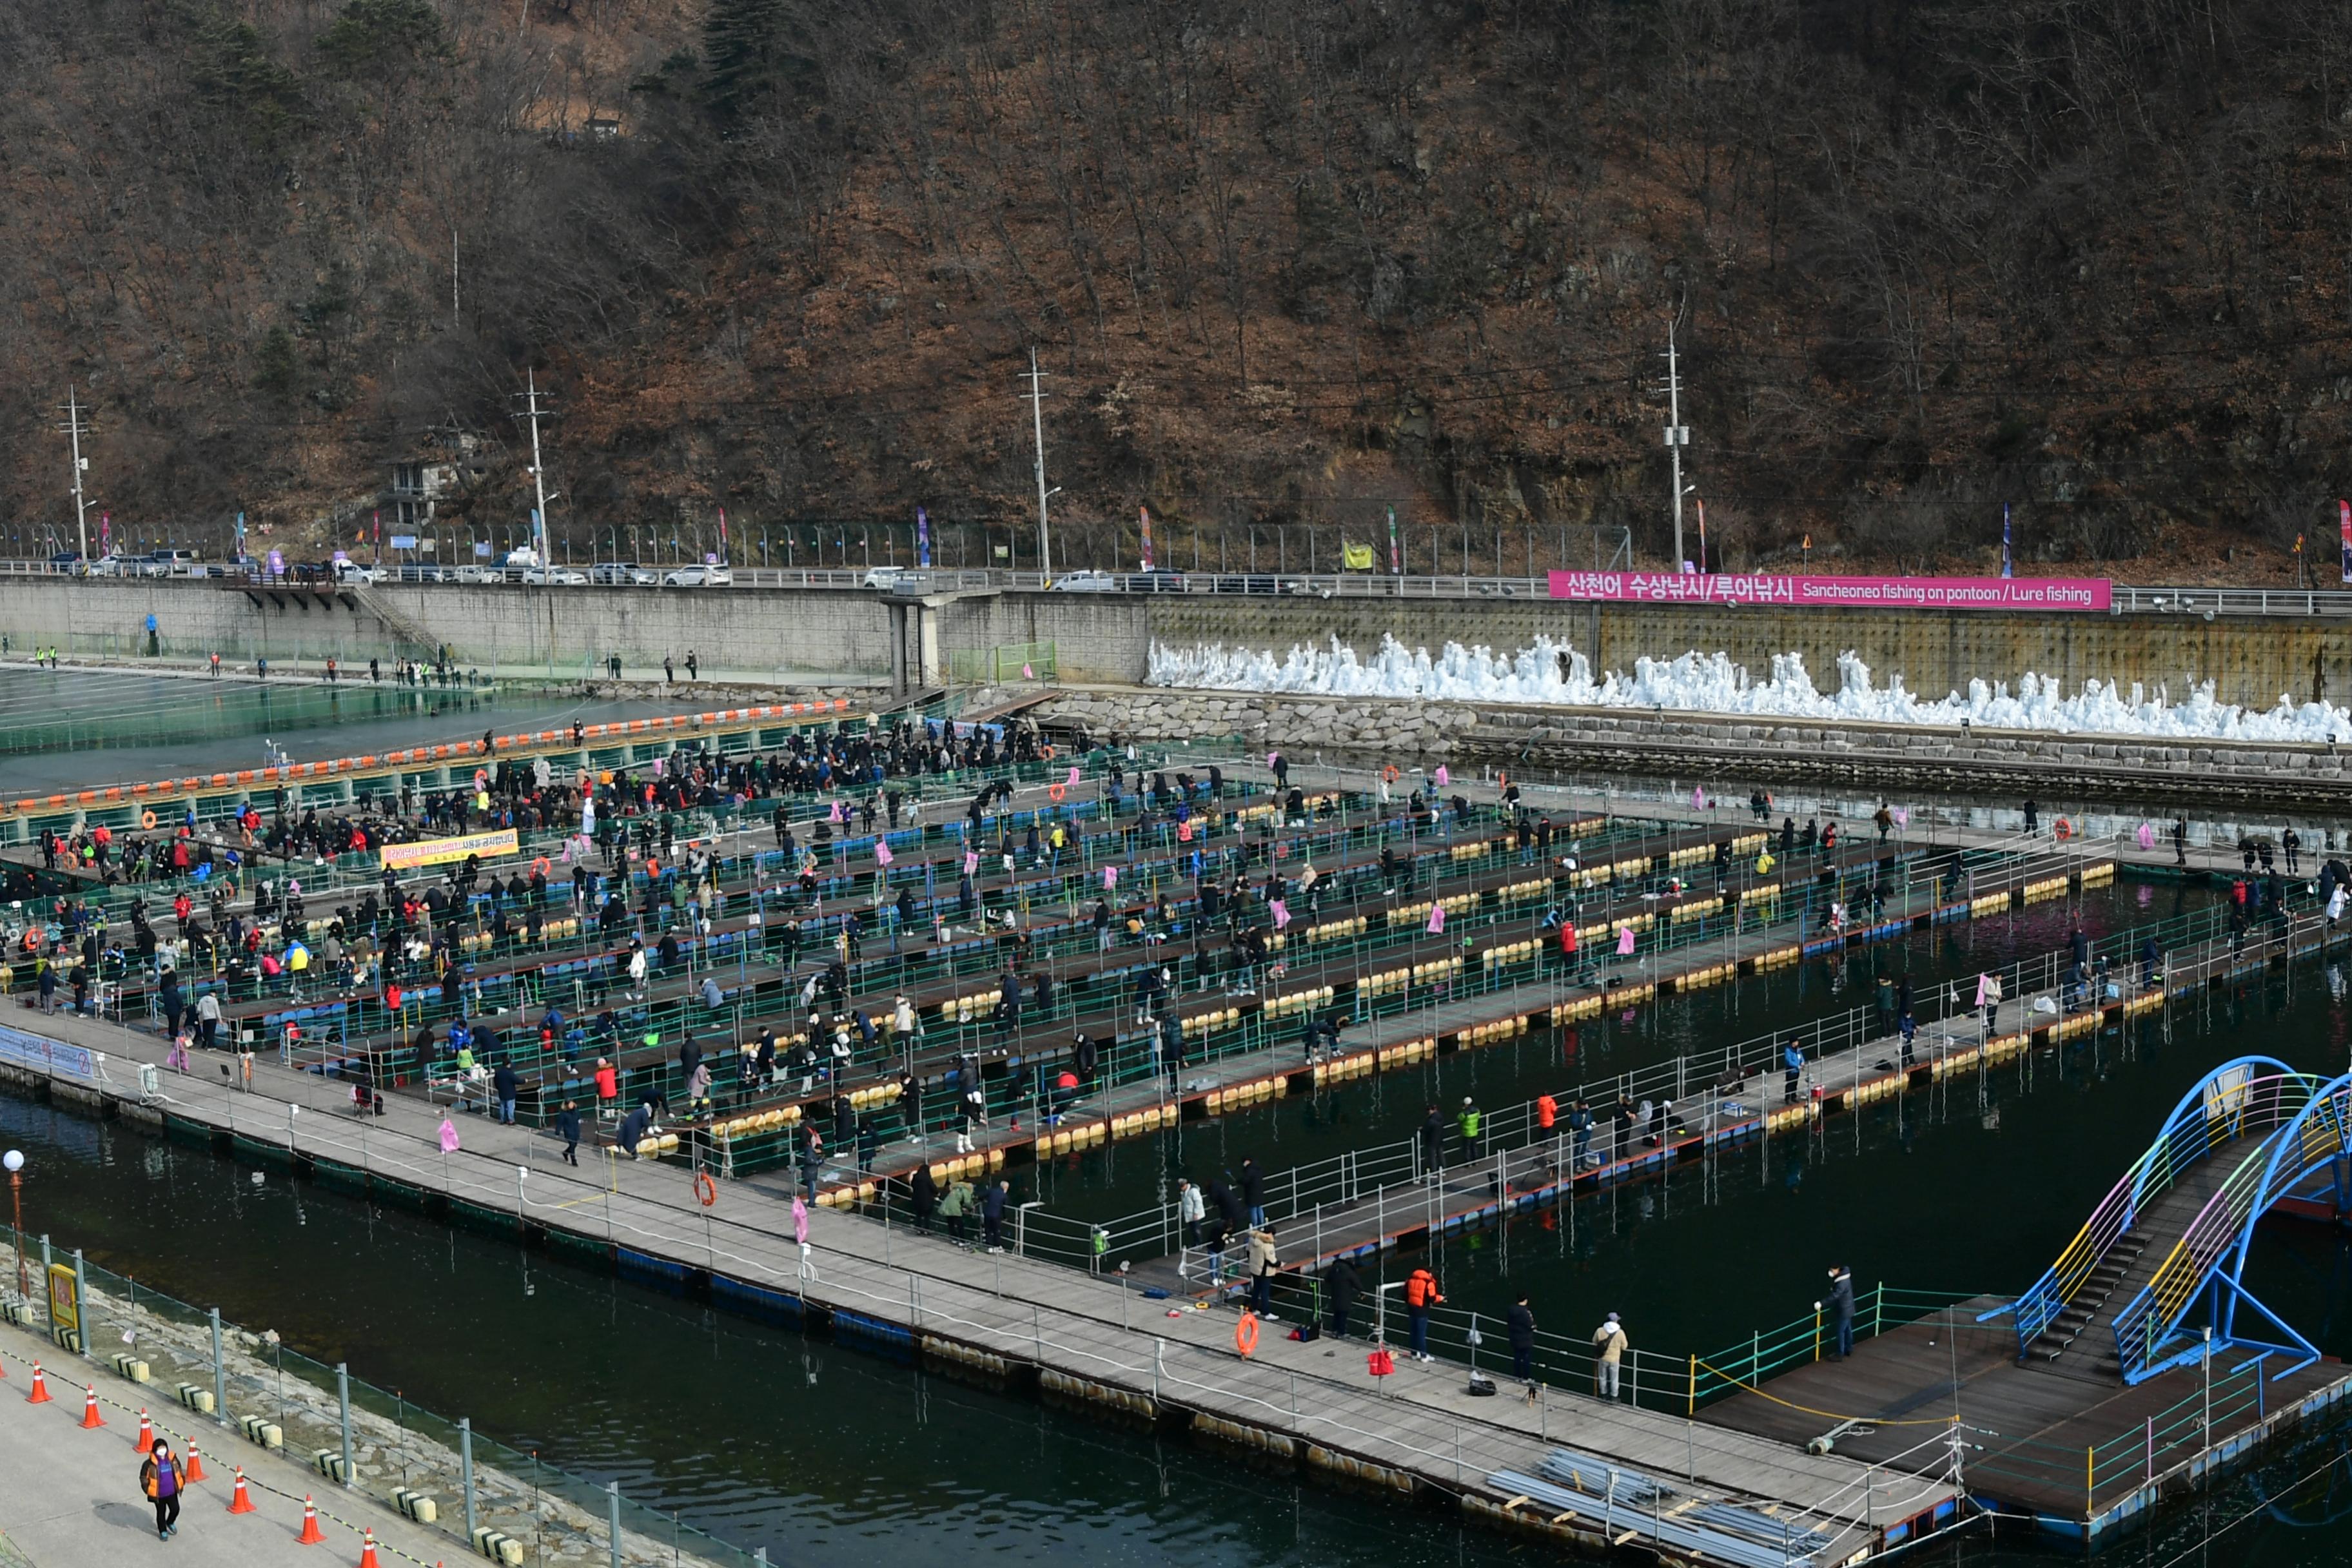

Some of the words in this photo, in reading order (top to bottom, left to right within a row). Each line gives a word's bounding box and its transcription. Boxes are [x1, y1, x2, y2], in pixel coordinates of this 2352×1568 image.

[1567, 574, 1622, 598] 산천어
[1629, 575, 1794, 602] 수상낚시/루어낚시
[1803, 582, 1880, 598] Sancheoneo
[1882, 583, 1925, 603] fishing
[1927, 588, 1944, 600] on
[1946, 586, 2001, 603] pontoon
[2010, 585, 2044, 601] Lure
[2046, 585, 2092, 605] fishing
